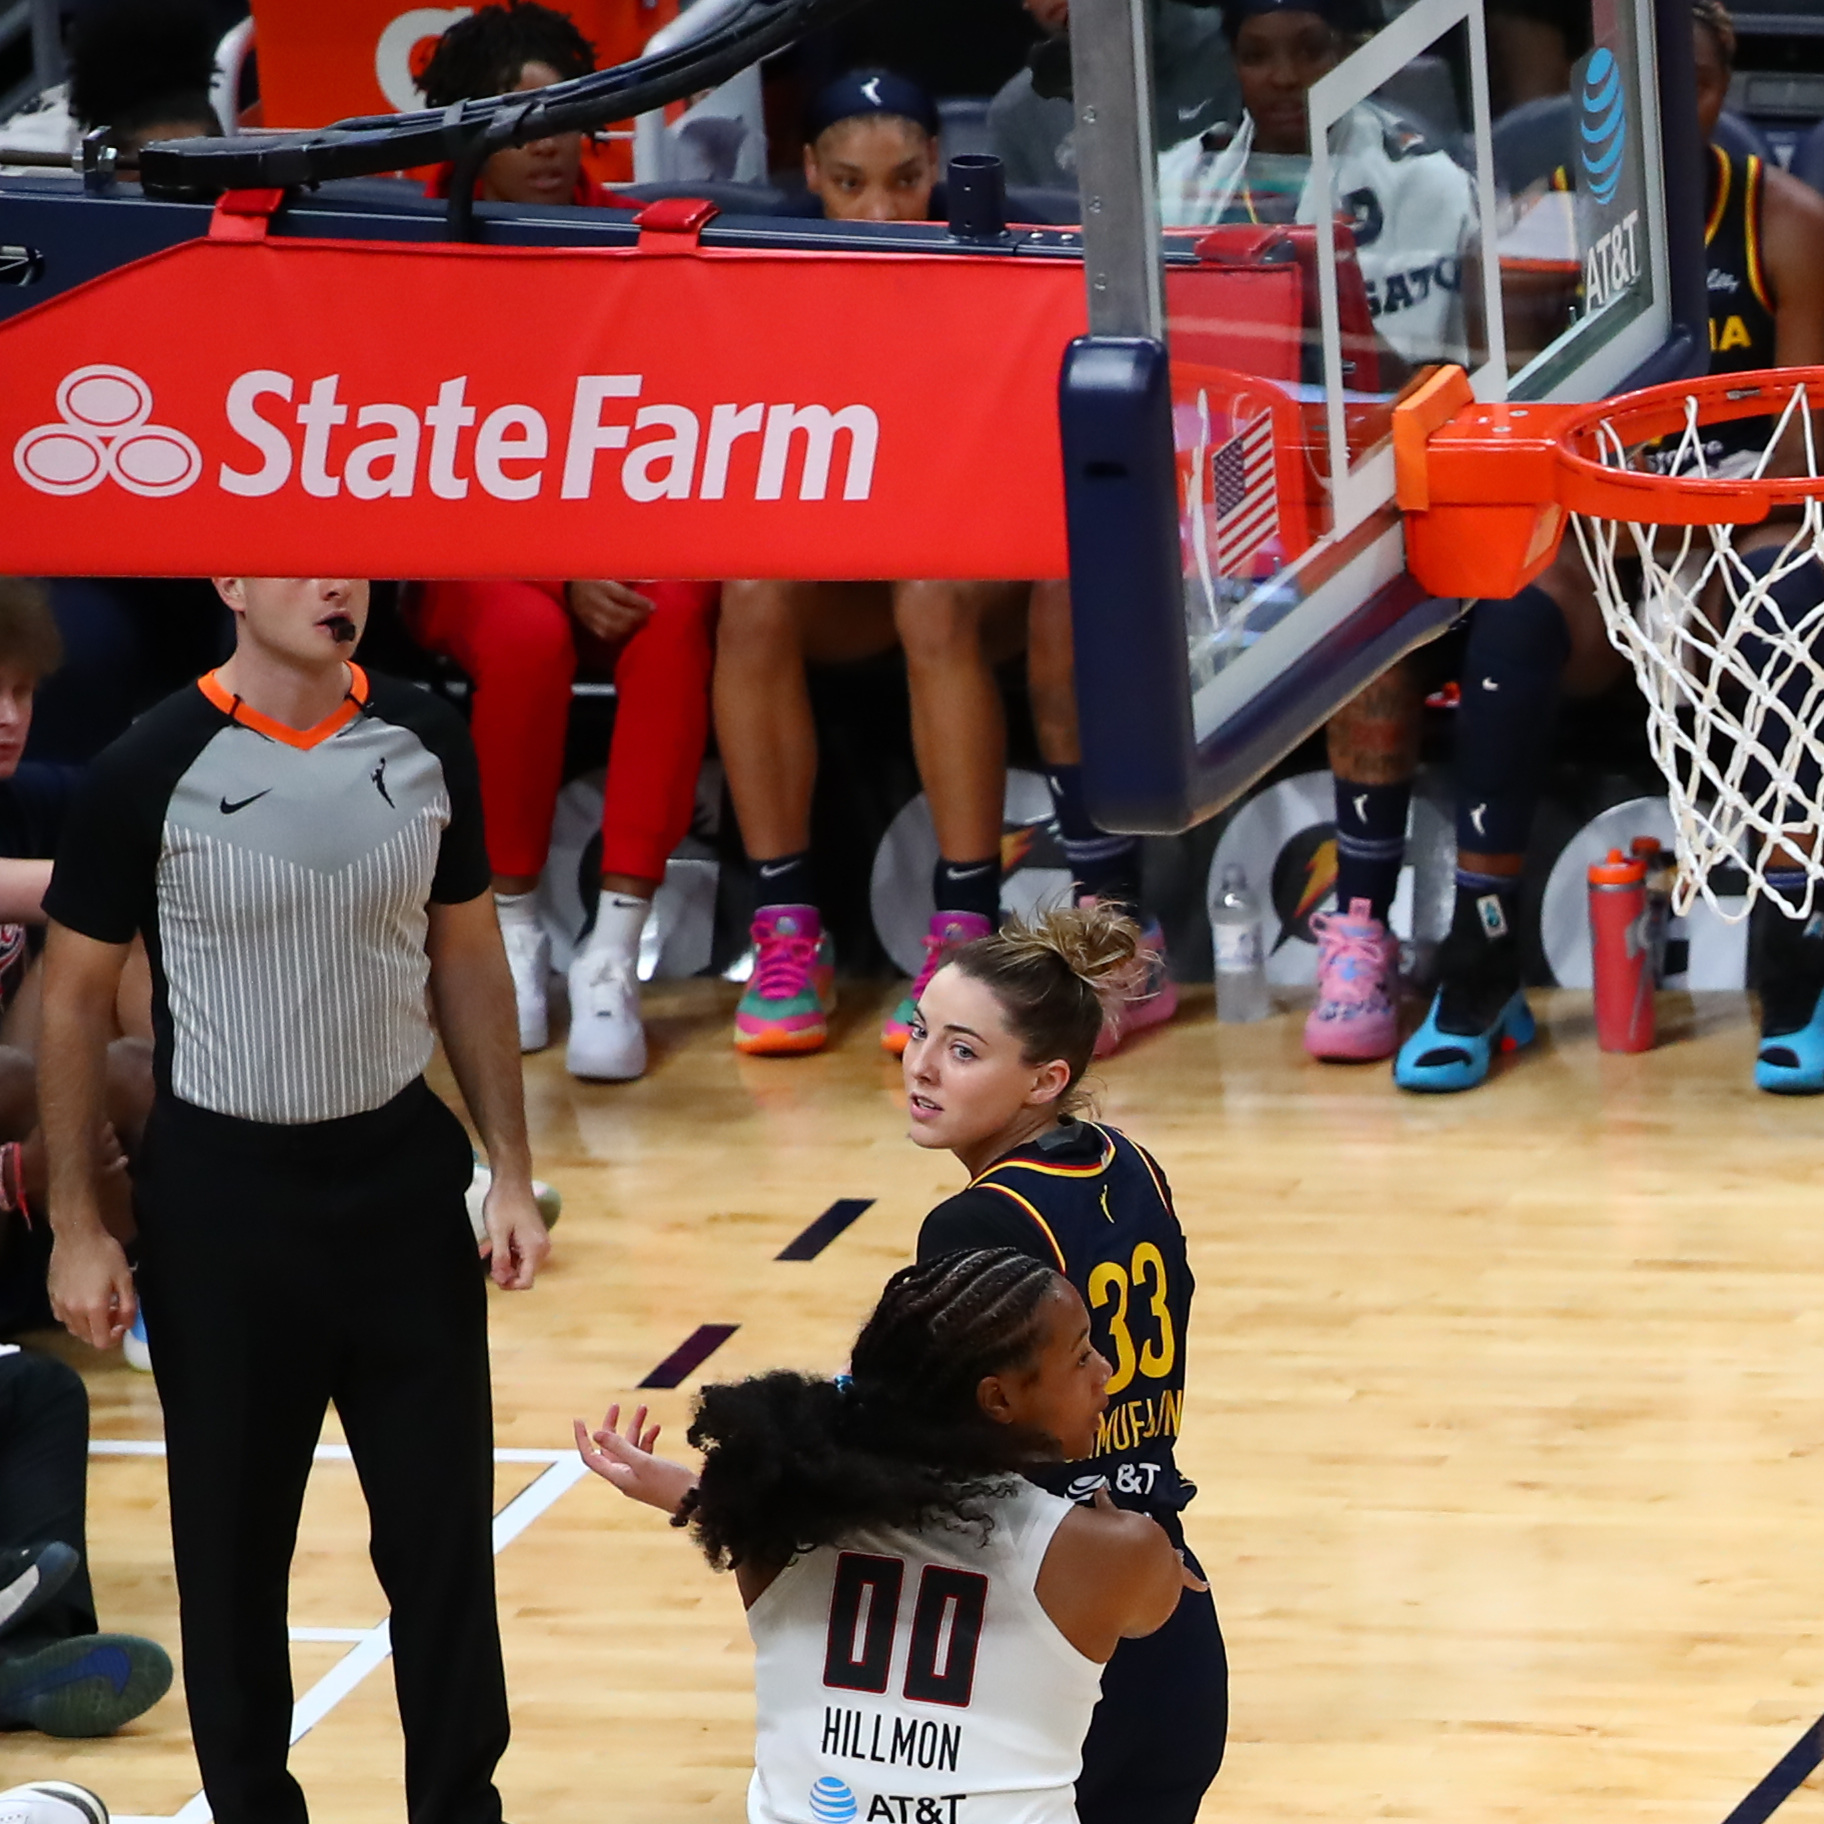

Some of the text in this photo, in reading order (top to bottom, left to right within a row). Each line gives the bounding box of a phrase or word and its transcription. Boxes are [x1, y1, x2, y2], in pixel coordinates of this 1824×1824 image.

[1585, 209, 1640, 314] AT&T
[1088, 1242, 1176, 1395] 33
[822, 1550, 989, 1710] 00
[821, 1706, 962, 1773] HILLMON
